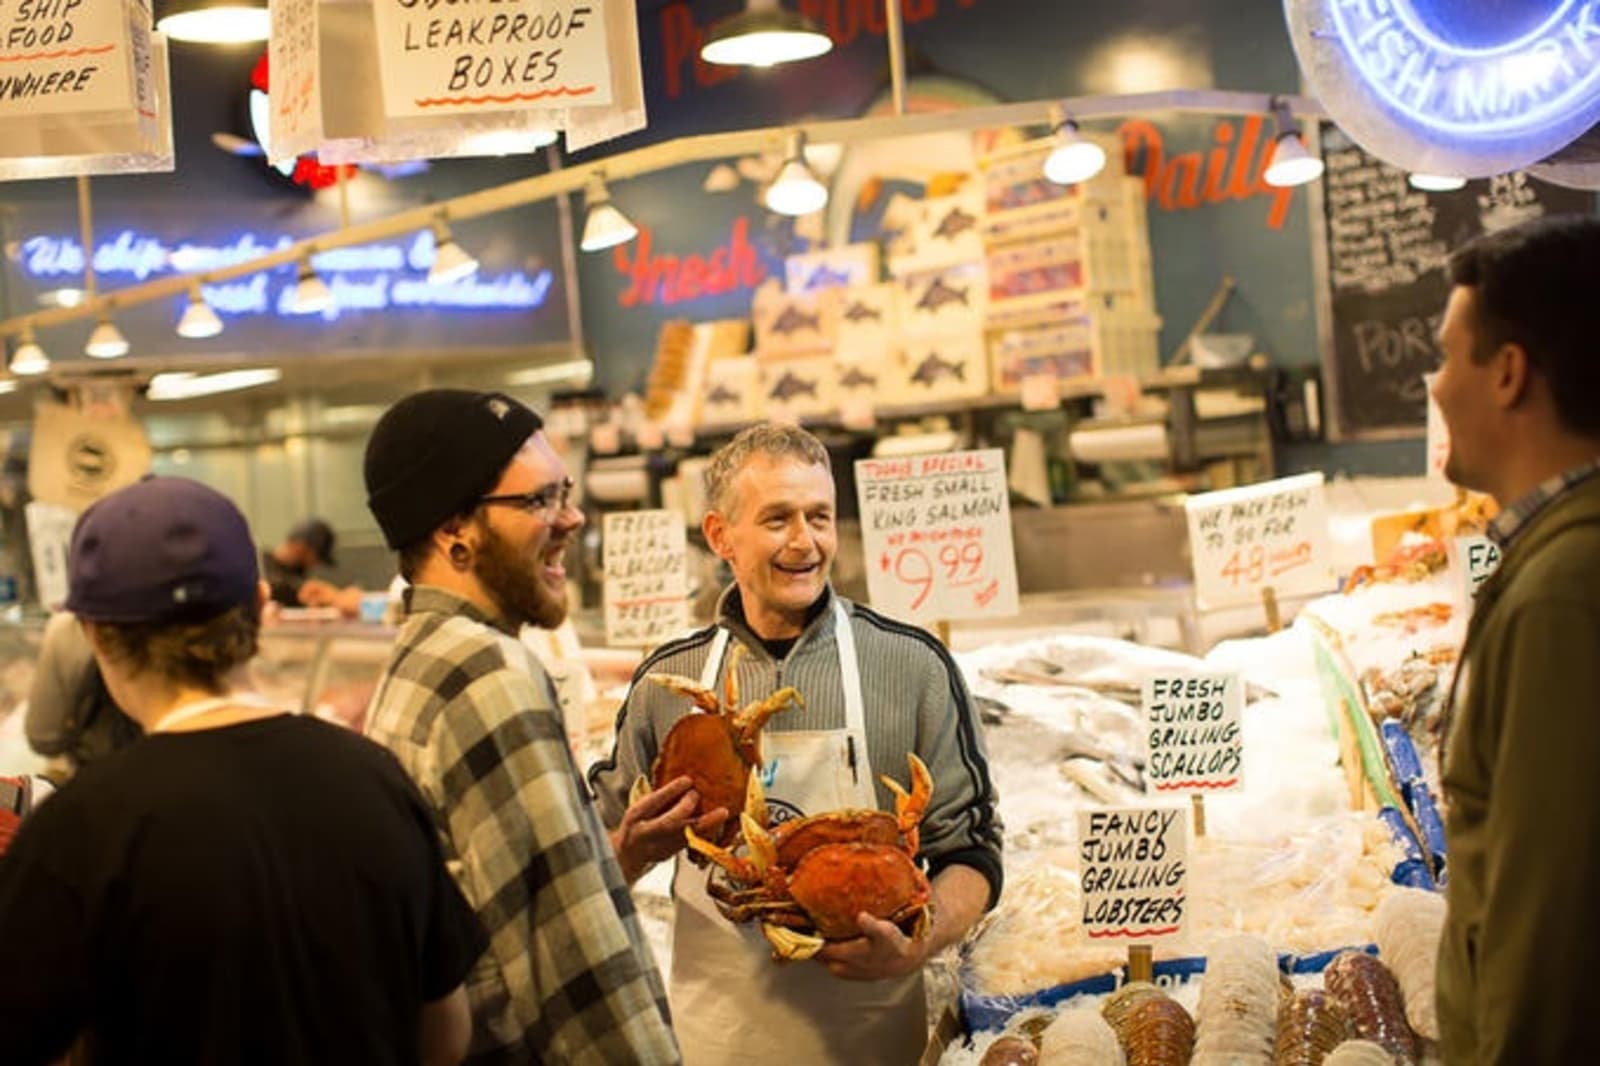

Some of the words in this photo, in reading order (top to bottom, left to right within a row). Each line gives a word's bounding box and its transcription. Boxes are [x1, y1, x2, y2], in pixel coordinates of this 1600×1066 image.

[15, 0, 82, 23] SHIP
[0, 22, 75, 49] FOOD
[405, 8, 592, 51] LEAKPROOF
[447, 49, 562, 91] BOXES
[1118, 114, 1308, 230] Daily
[613, 215, 764, 308] Fresh
[865, 484, 924, 501] FRESH
[932, 477, 992, 499] SMALL
[872, 505, 917, 529] KING
[927, 493, 1003, 525] SALMON
[1153, 677, 1226, 700] FRESH
[1150, 701, 1224, 723] JUMBO
[1149, 721, 1241, 750] GRILLING
[1149, 746, 1242, 778] SCALLOPS
[1090, 809, 1178, 837] FANCY
[1082, 836, 1167, 863] JUMBO
[1081, 860, 1186, 894] GRILLING
[1082, 896, 1187, 926] LOBSTERS
